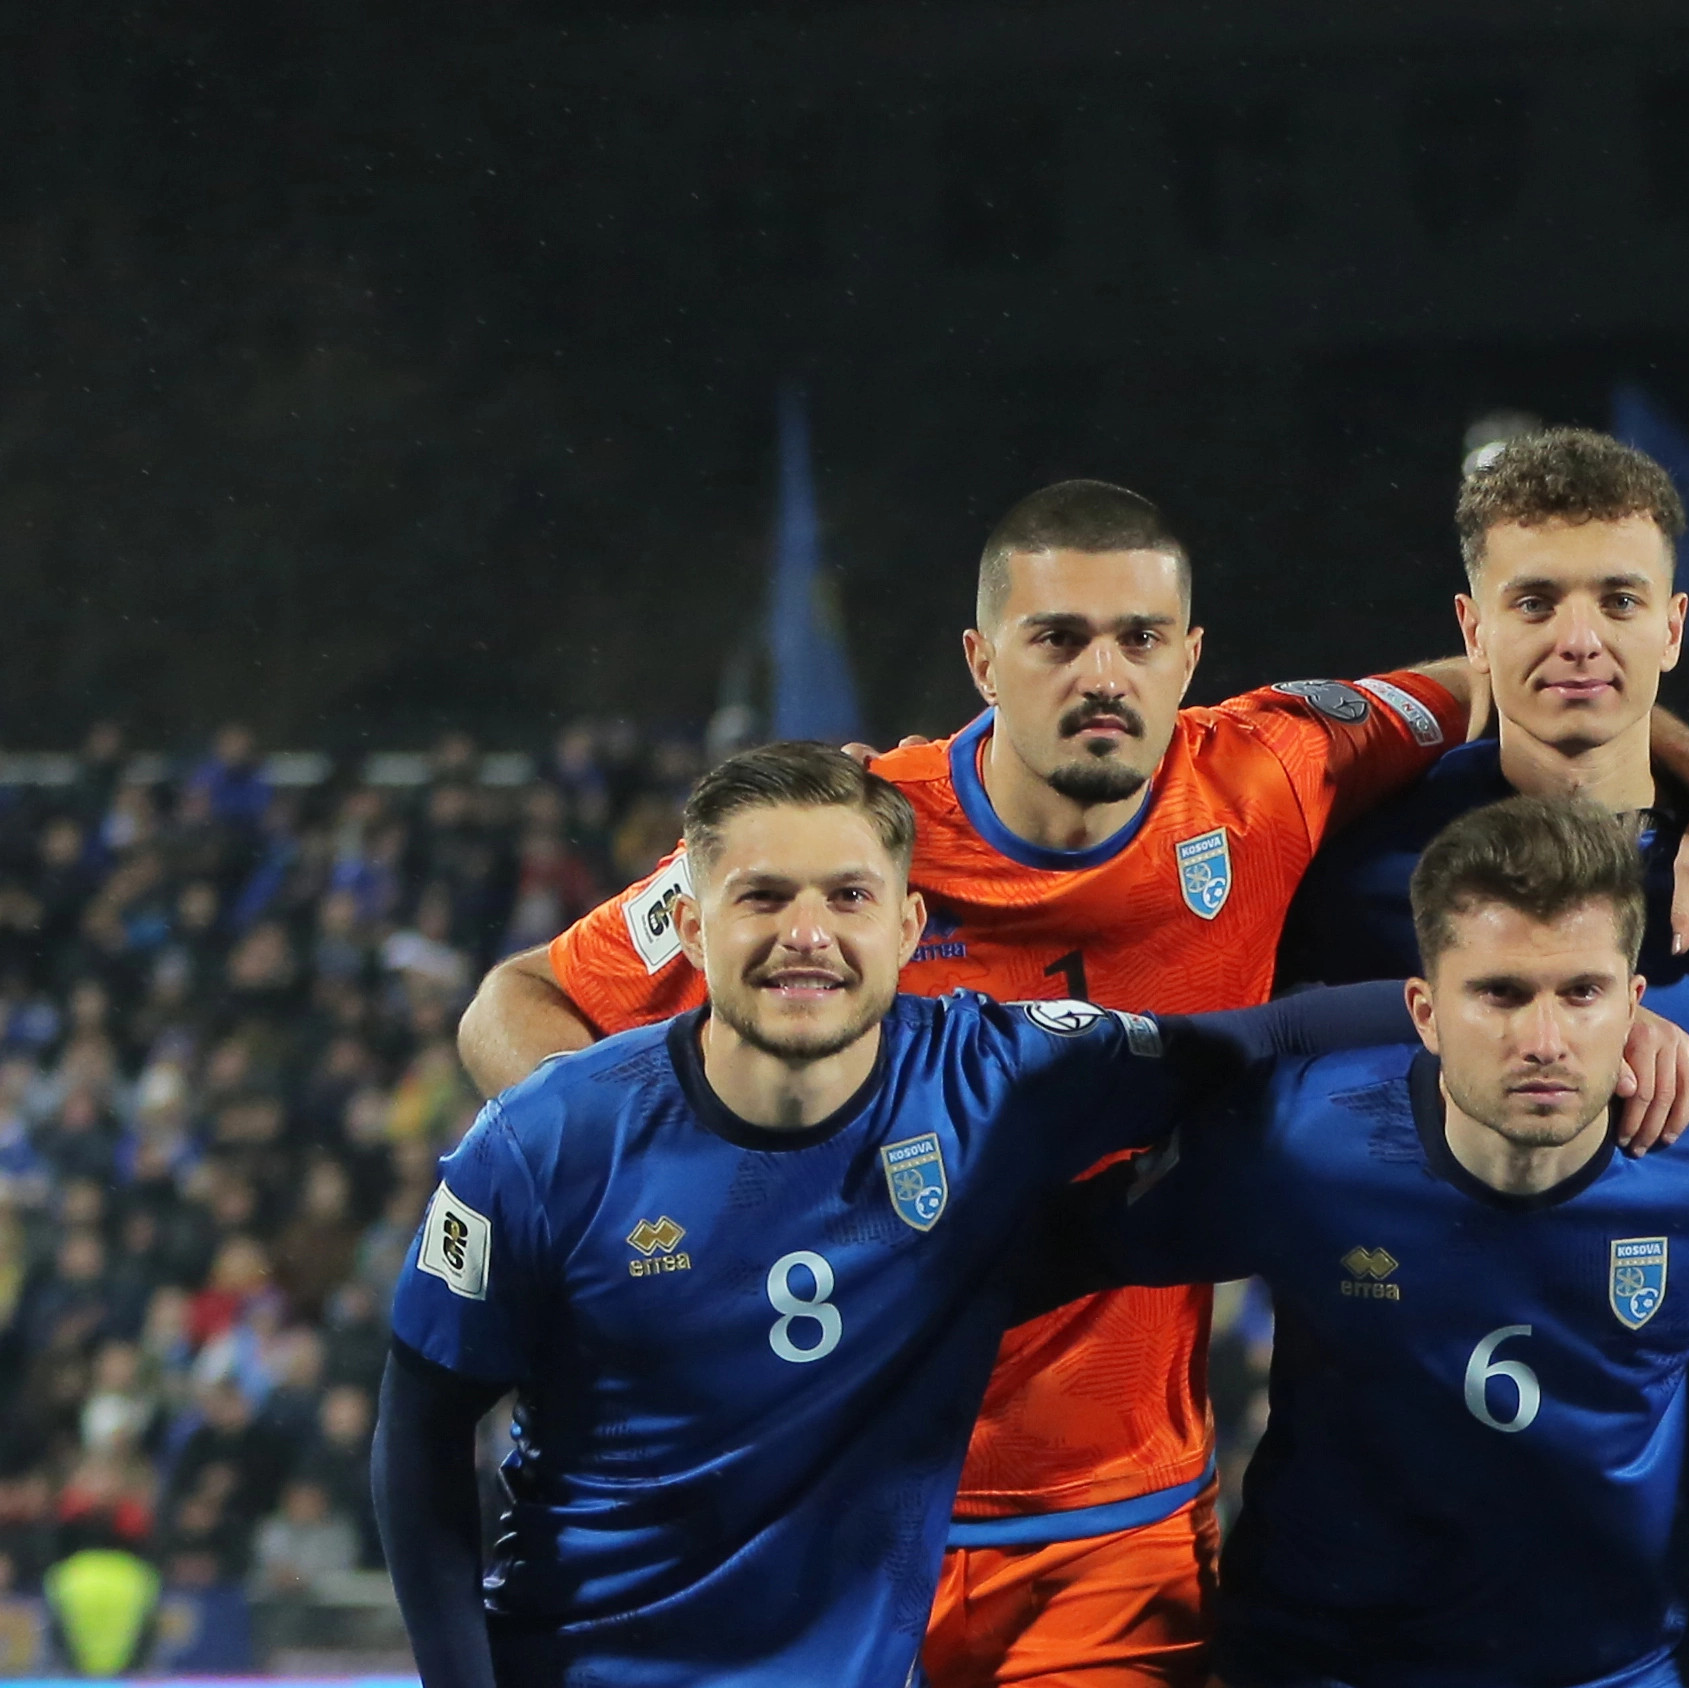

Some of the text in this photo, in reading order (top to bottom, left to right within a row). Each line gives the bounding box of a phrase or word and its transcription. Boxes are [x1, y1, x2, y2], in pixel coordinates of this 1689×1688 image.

[1181, 836, 1221, 857] KOSOVA
[888, 1141, 935, 1163] KOSOVA
[1616, 1242, 1662, 1257] KOSOVA
[629, 1253, 692, 1279] errea
[1340, 1280, 1401, 1301] errea
[766, 1250, 842, 1363] 8
[1464, 1324, 1541, 1432] 6
